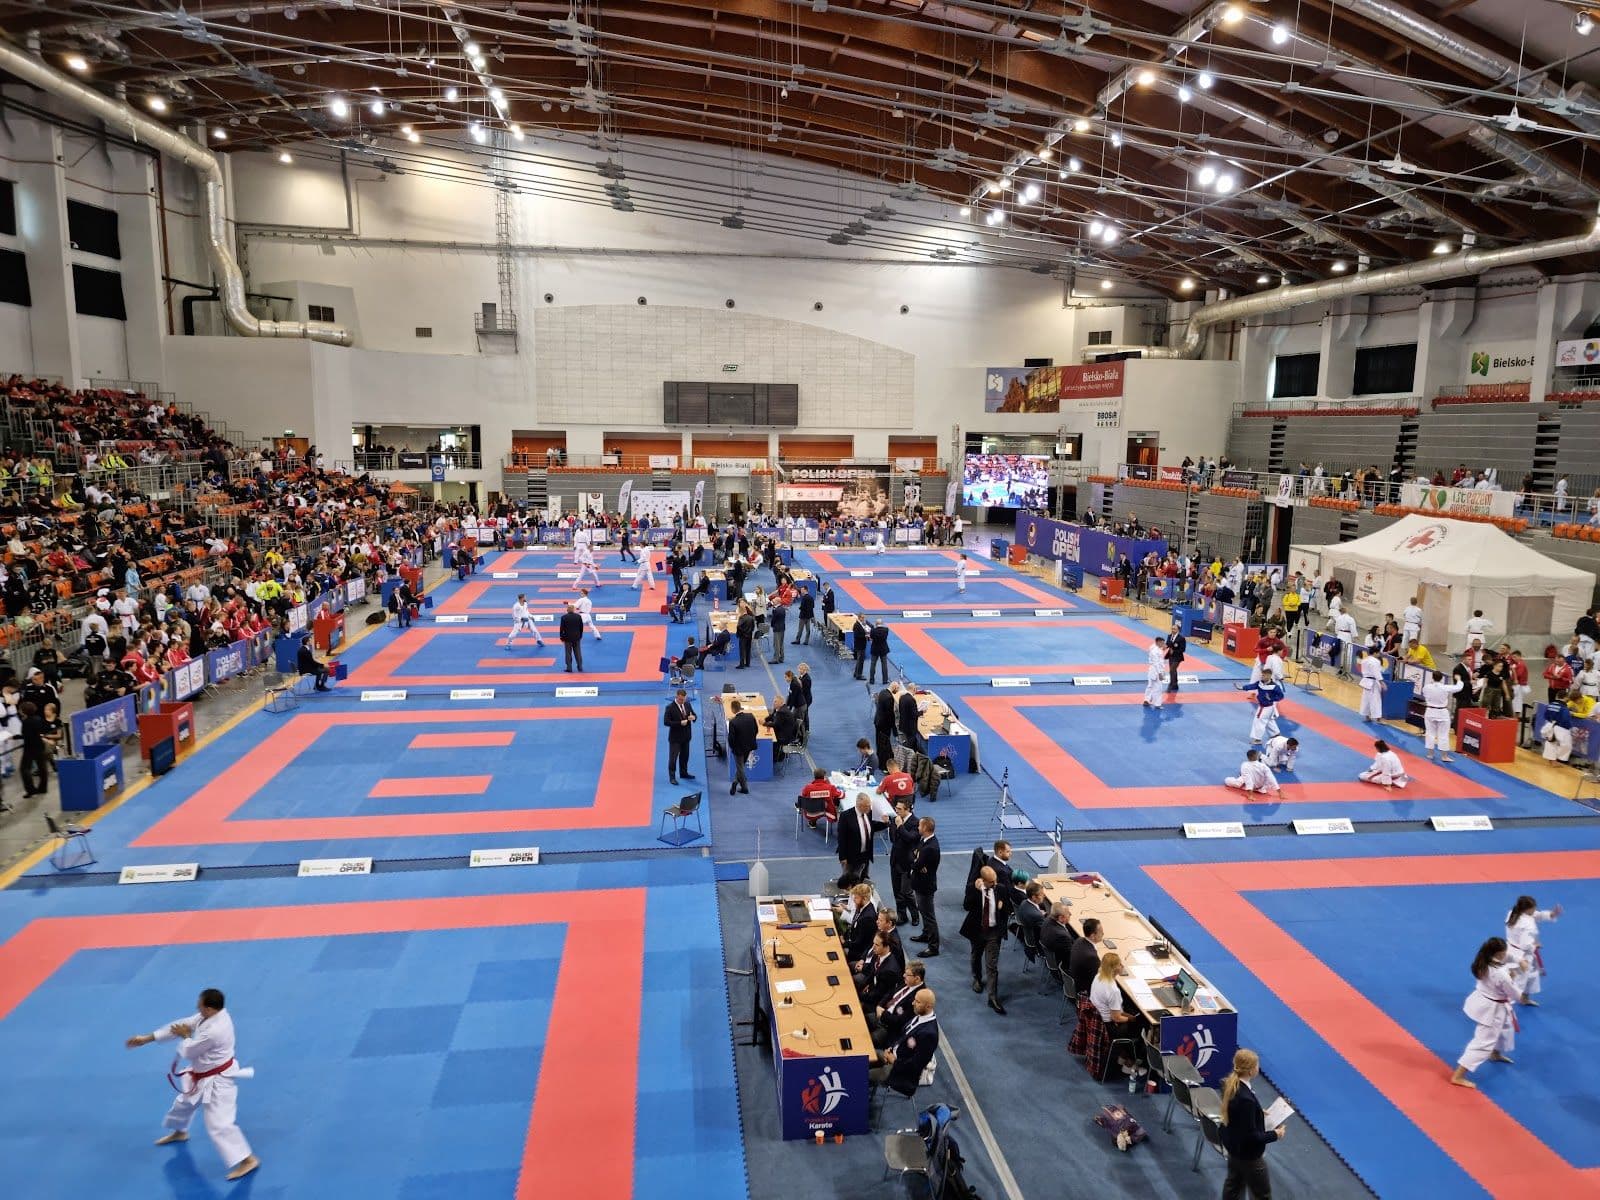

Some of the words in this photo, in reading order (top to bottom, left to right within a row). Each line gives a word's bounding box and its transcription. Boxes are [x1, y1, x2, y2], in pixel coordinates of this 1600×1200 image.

[791, 469, 836, 479] POLISH
[1055, 528, 1080, 547] POLISH
[1052, 540, 1080, 563] OPEN
[84, 709, 125, 730] POLISH
[82, 718, 128, 746] OPEN
